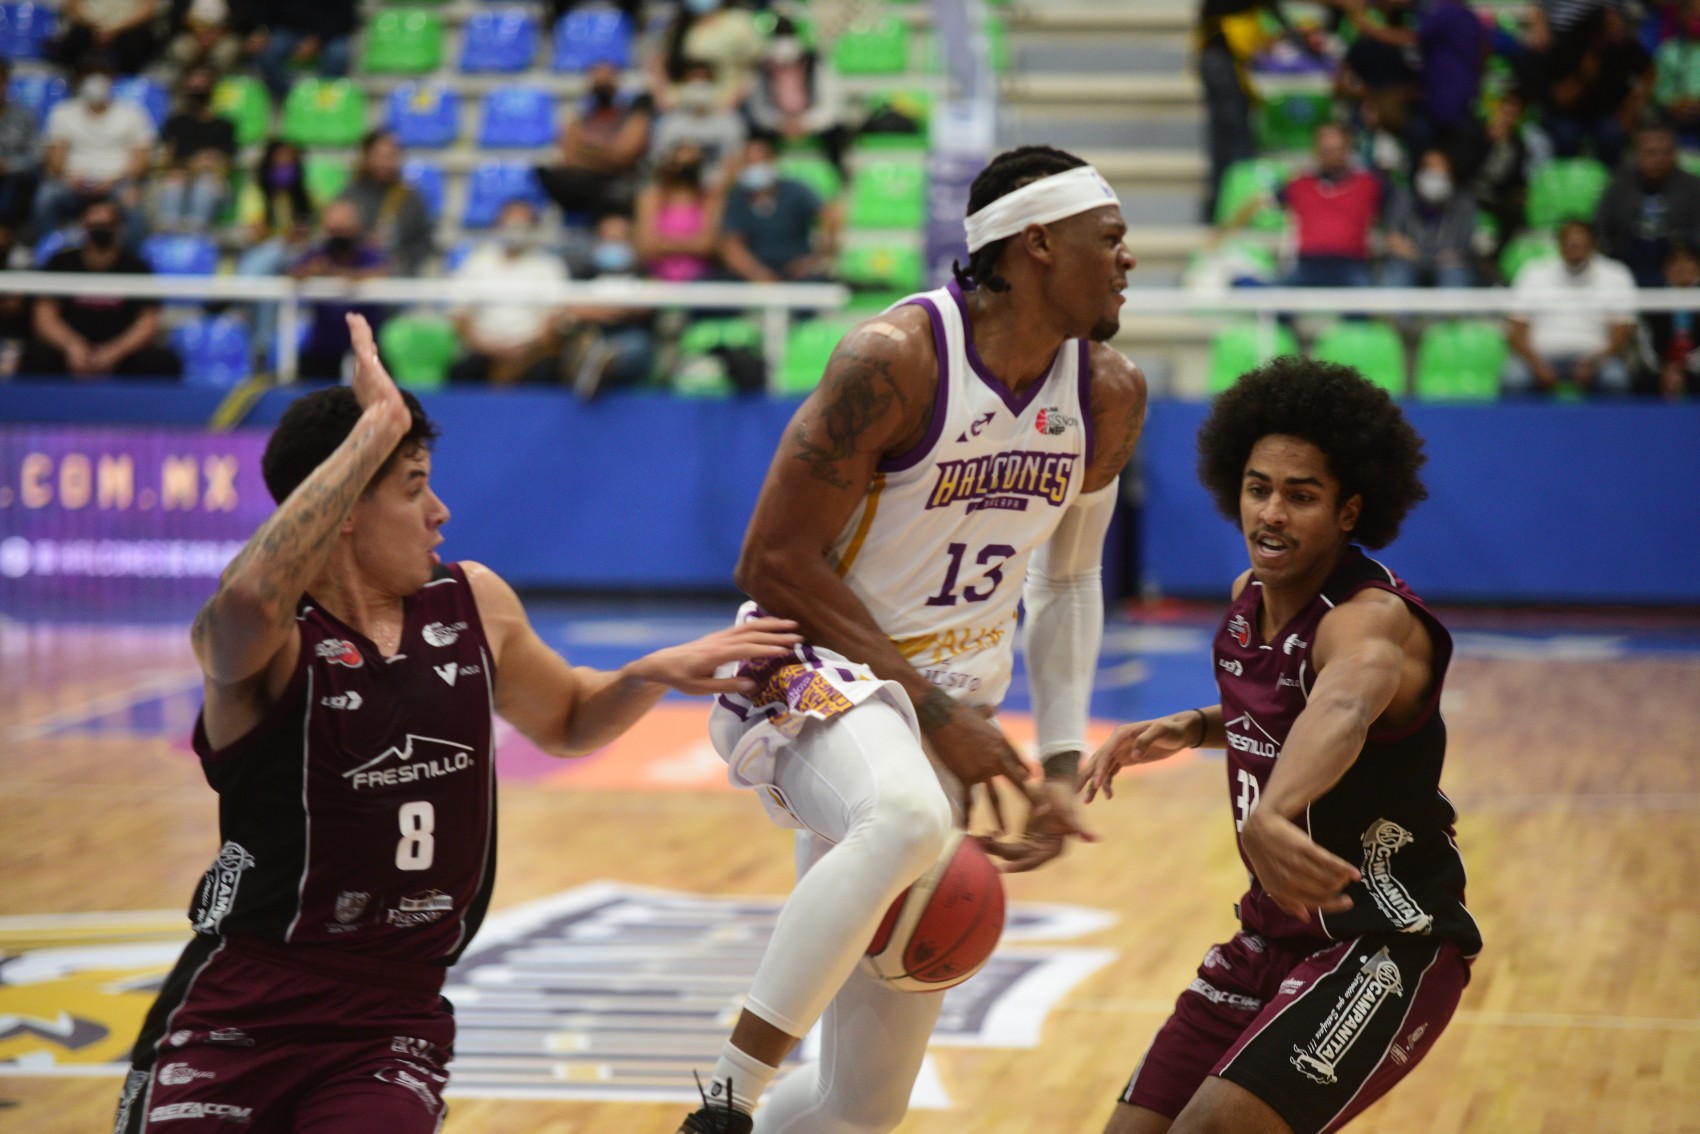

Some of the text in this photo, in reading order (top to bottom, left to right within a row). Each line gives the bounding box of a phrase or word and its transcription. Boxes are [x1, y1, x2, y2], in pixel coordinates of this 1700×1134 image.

[926, 451, 1079, 509] HALCONES
[925, 543, 1016, 606] 13
[352, 752, 469, 790] FRESNILLO
[395, 801, 435, 871] 8
[1372, 846, 1417, 920] CMPANITA
[1379, 963, 1398, 986] GAS
[1321, 980, 1383, 1060] CAMPANITA
